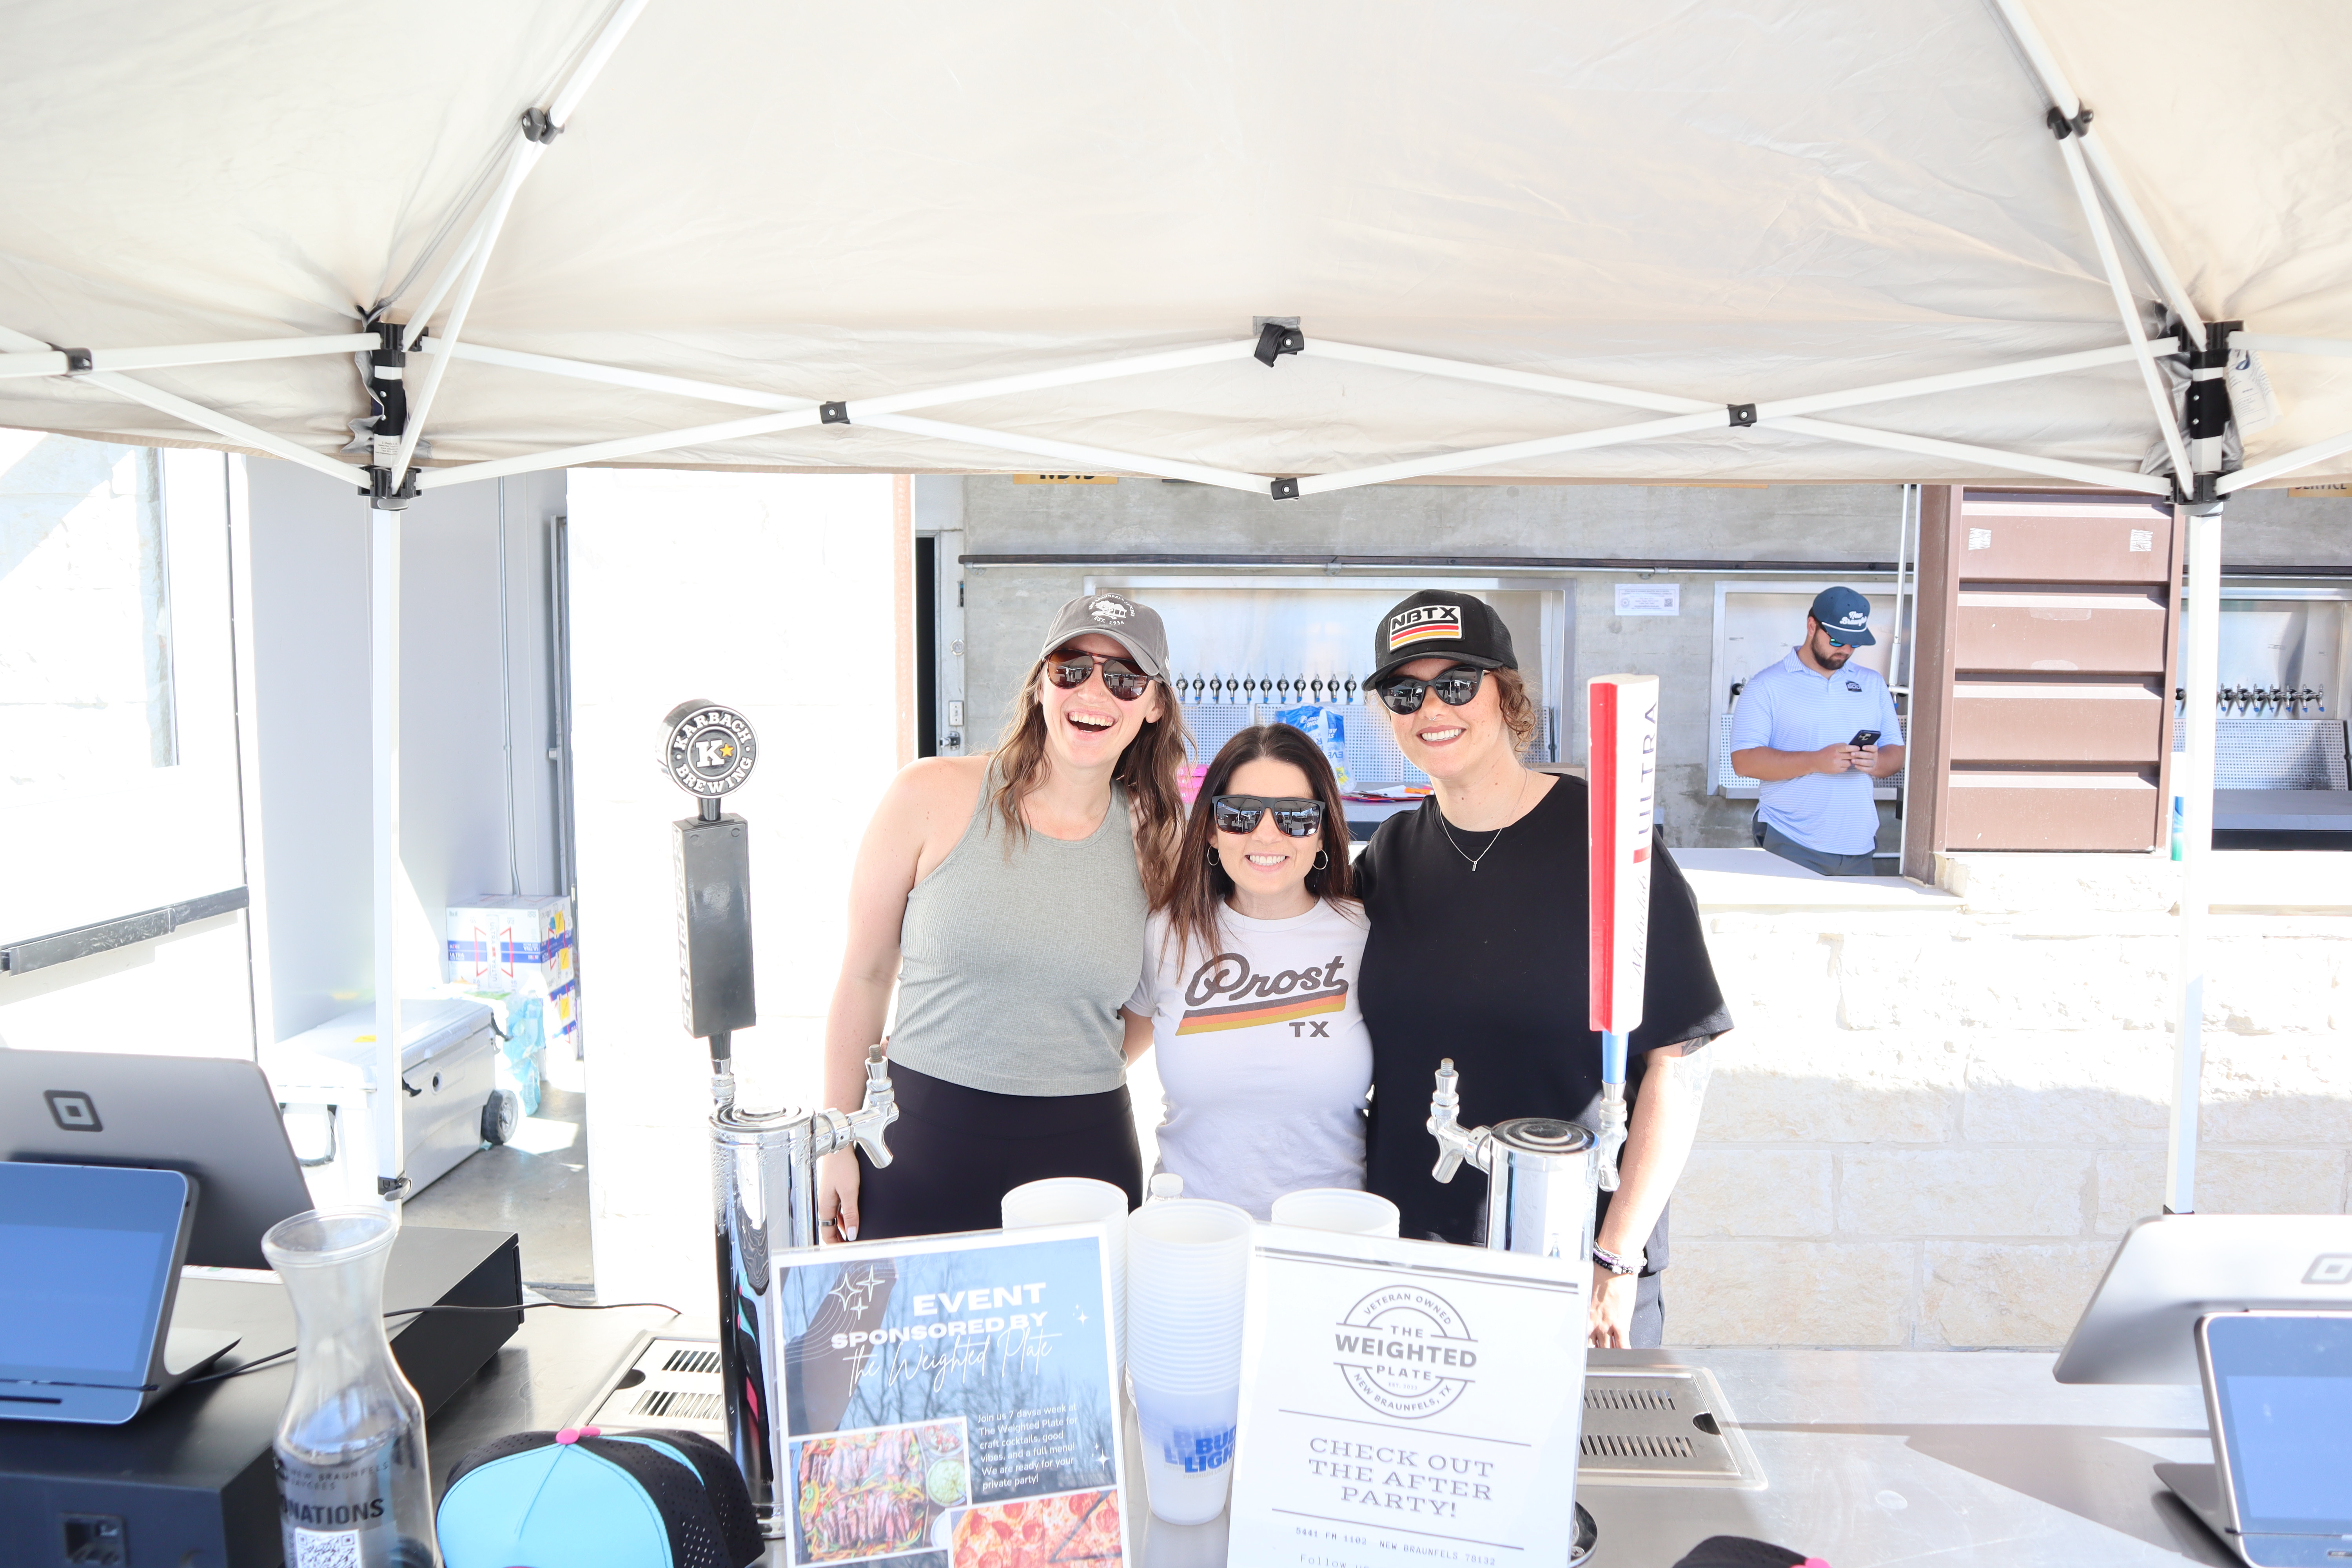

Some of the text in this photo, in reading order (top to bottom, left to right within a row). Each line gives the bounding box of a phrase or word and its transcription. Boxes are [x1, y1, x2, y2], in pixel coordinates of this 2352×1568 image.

[1392, 606, 1458, 630] NBTX
[673, 712, 752, 750] KARBACH
[696, 739, 725, 768] K
[1638, 701, 1657, 835] ULTRA
[676, 757, 753, 793] BREWING
[1185, 953, 1349, 1006] Prost
[1289, 1021, 1330, 1038] TX
[913, 1282, 1046, 1316] EVENT
[1364, 1293, 1451, 1325] VETERAN OWNED
[831, 1311, 1048, 1350] SPONSORED BY
[1390, 1325, 1423, 1338] THE
[842, 1326, 1062, 1397] the Weighted Plate
[1335, 1334, 1477, 1368] WEIGHTED
[1377, 1365, 1431, 1381] PLATE
[1354, 1373, 1452, 1411] NEW BRAUNFELS, TX
[978, 1414, 994, 1423] Join
[1009, 1410, 1014, 1419] 7
[1044, 1403, 1066, 1414] week
[1069, 1403, 1077, 1411] at
[978, 1427, 995, 1436] The
[997, 1420, 1039, 1434] Weighted
[1042, 1419, 1063, 1428] Plate
[980, 1430, 1063, 1450] craft cocktails, good
[981, 1454, 1005, 1463] vibes,
[1007, 1449, 1023, 1459] and
[1033, 1445, 1047, 1456] full
[1049, 1442, 1075, 1454] menu!
[318, 1462, 388, 1481] BRAUNFELS
[982, 1457, 1074, 1476] We are ready for your
[1185, 1441, 1235, 1473] LIGH
[1310, 1438, 1494, 1477] CHECK OUT
[983, 1473, 1038, 1491] private party!
[1183, 1471, 1214, 1480] PREMIUM
[1308, 1459, 1492, 1501] THE AFTER
[1341, 1486, 1457, 1517] PARTY!
[1296, 1527, 1495, 1566] 5441 FM 1102 NEW BRAUNFELS 78132
[1301, 1554, 1346, 1568] Follow
